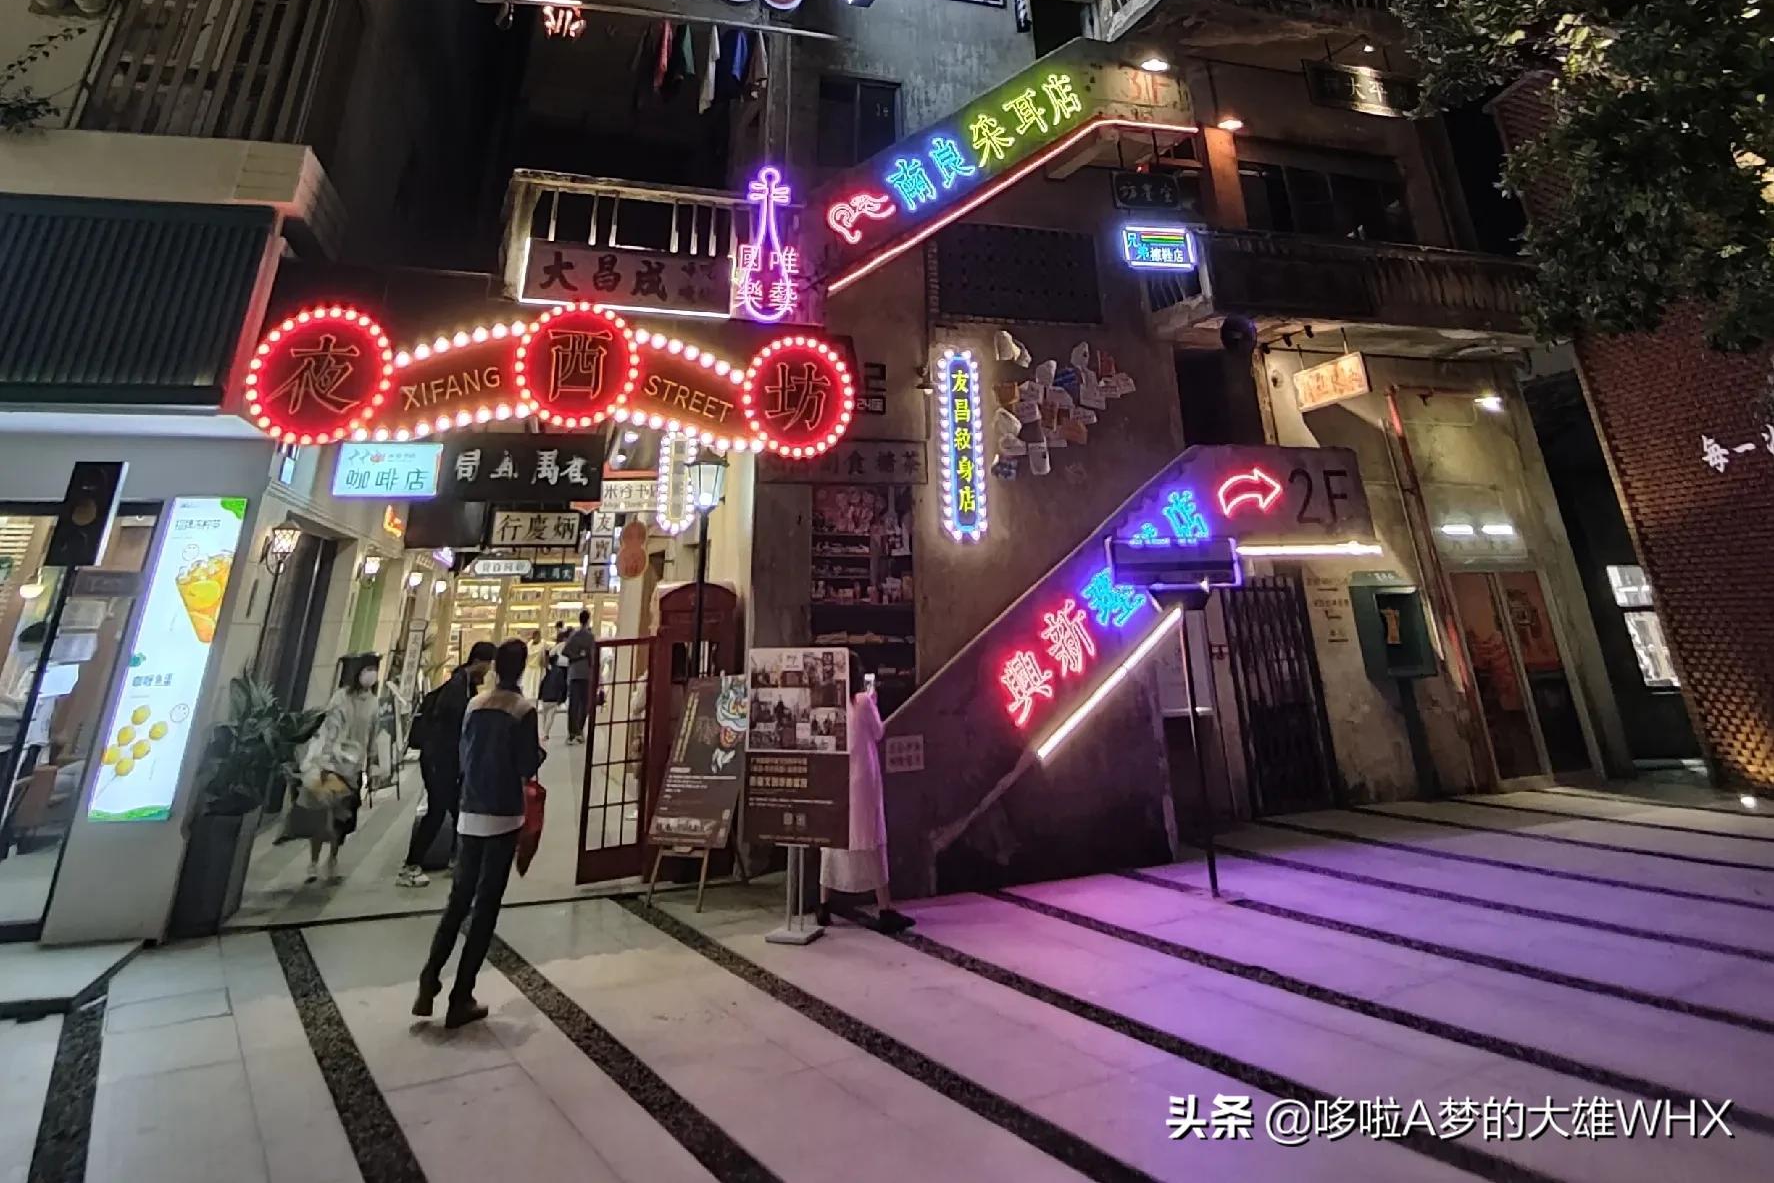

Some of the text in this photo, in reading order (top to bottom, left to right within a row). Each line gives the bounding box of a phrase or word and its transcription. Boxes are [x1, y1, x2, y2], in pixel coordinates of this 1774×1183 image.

[400, 366, 735, 425] XIFANG STREET
[547, 327, 614, 403] 西
[764, 361, 831, 432] 坊
[345, 467, 430, 492] 咖啡店
[1287, 467, 1350, 524] 2F
